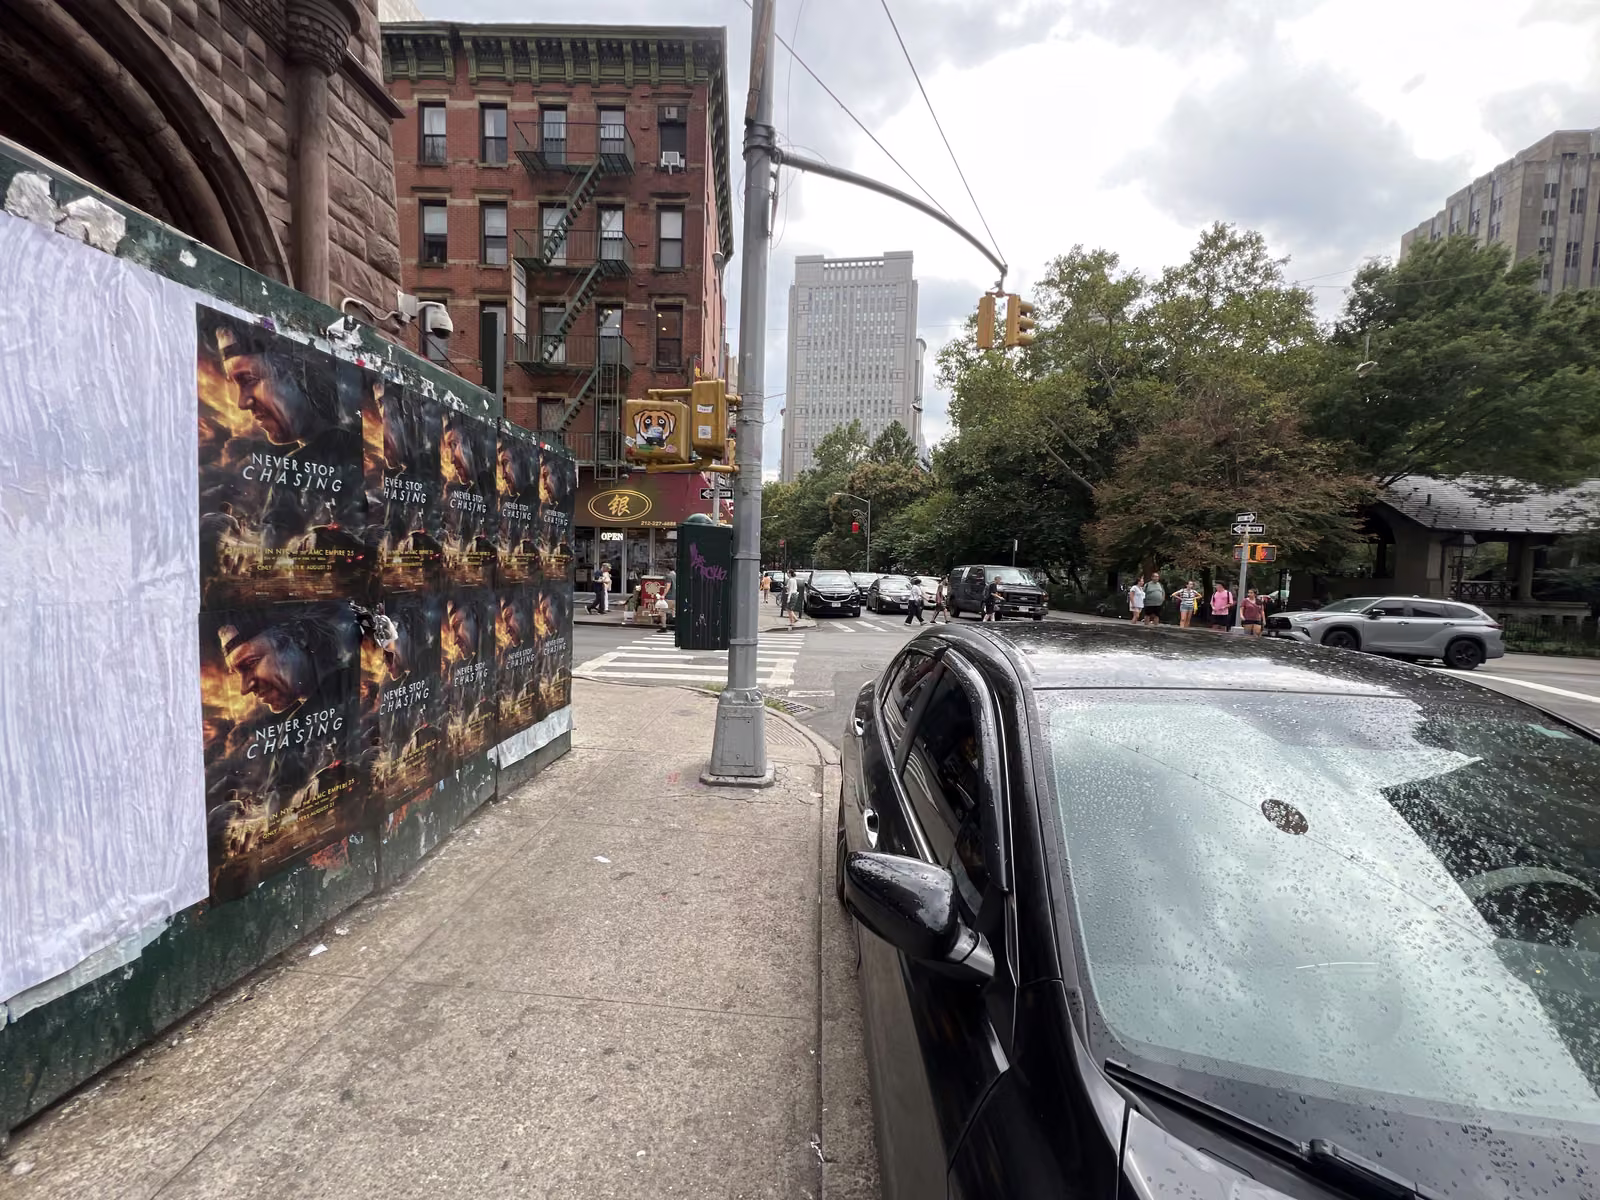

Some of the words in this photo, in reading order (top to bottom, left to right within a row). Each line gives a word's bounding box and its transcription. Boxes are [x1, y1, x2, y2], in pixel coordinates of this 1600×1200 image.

[252, 452, 298, 471] NEVER
[304, 461, 335, 477] STOP
[242, 465, 342, 492] CHASING
[384, 476, 403, 489] EVER
[405, 480, 423, 491] STOP
[383, 487, 427, 504] HASING
[452, 490, 471, 501] NEVER
[472, 494, 484, 503] STOP
[450, 498, 487, 514] CHASING
[502, 508, 532, 521] CHASING
[607, 494, 631, 517] 銀
[600, 532, 624, 541] OPEN
[456, 665, 473, 676] NEVER
[505, 653, 535, 670] CHASING
[454, 668, 488, 687] CHASING
[383, 686, 407, 702] NEVER
[409, 679, 425, 693] STOP
[379, 688, 430, 716] CHASING
[255, 718, 300, 741] NEVER
[305, 708, 336, 726] STOP
[246, 717, 343, 760] CHASING
